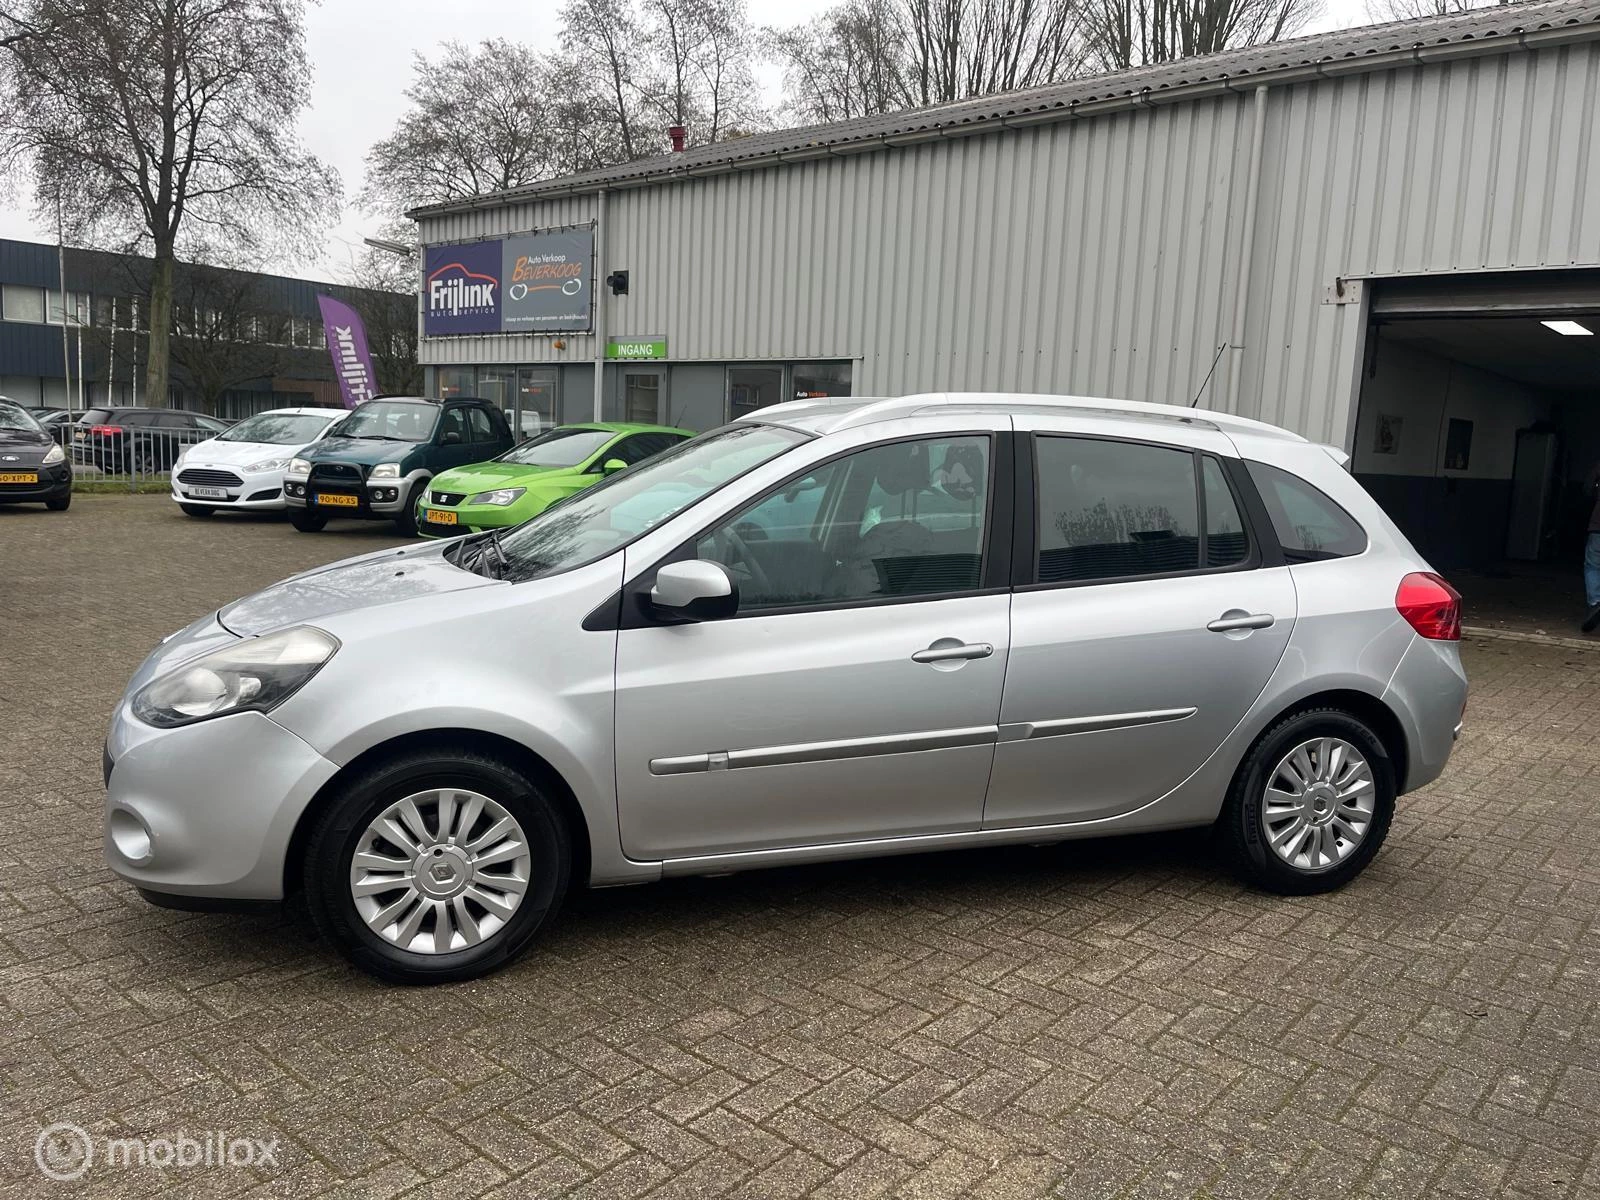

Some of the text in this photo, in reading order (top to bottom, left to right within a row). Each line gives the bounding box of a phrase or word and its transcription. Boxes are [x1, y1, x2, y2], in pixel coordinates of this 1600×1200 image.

[528, 253, 566, 264] Auto Verkoop
[512, 256, 582, 283] BEVERKOOG
[431, 278, 494, 316] Frijlink
[618, 344, 653, 356] INGANG
[319, 495, 356, 505] 90-NG-XS
